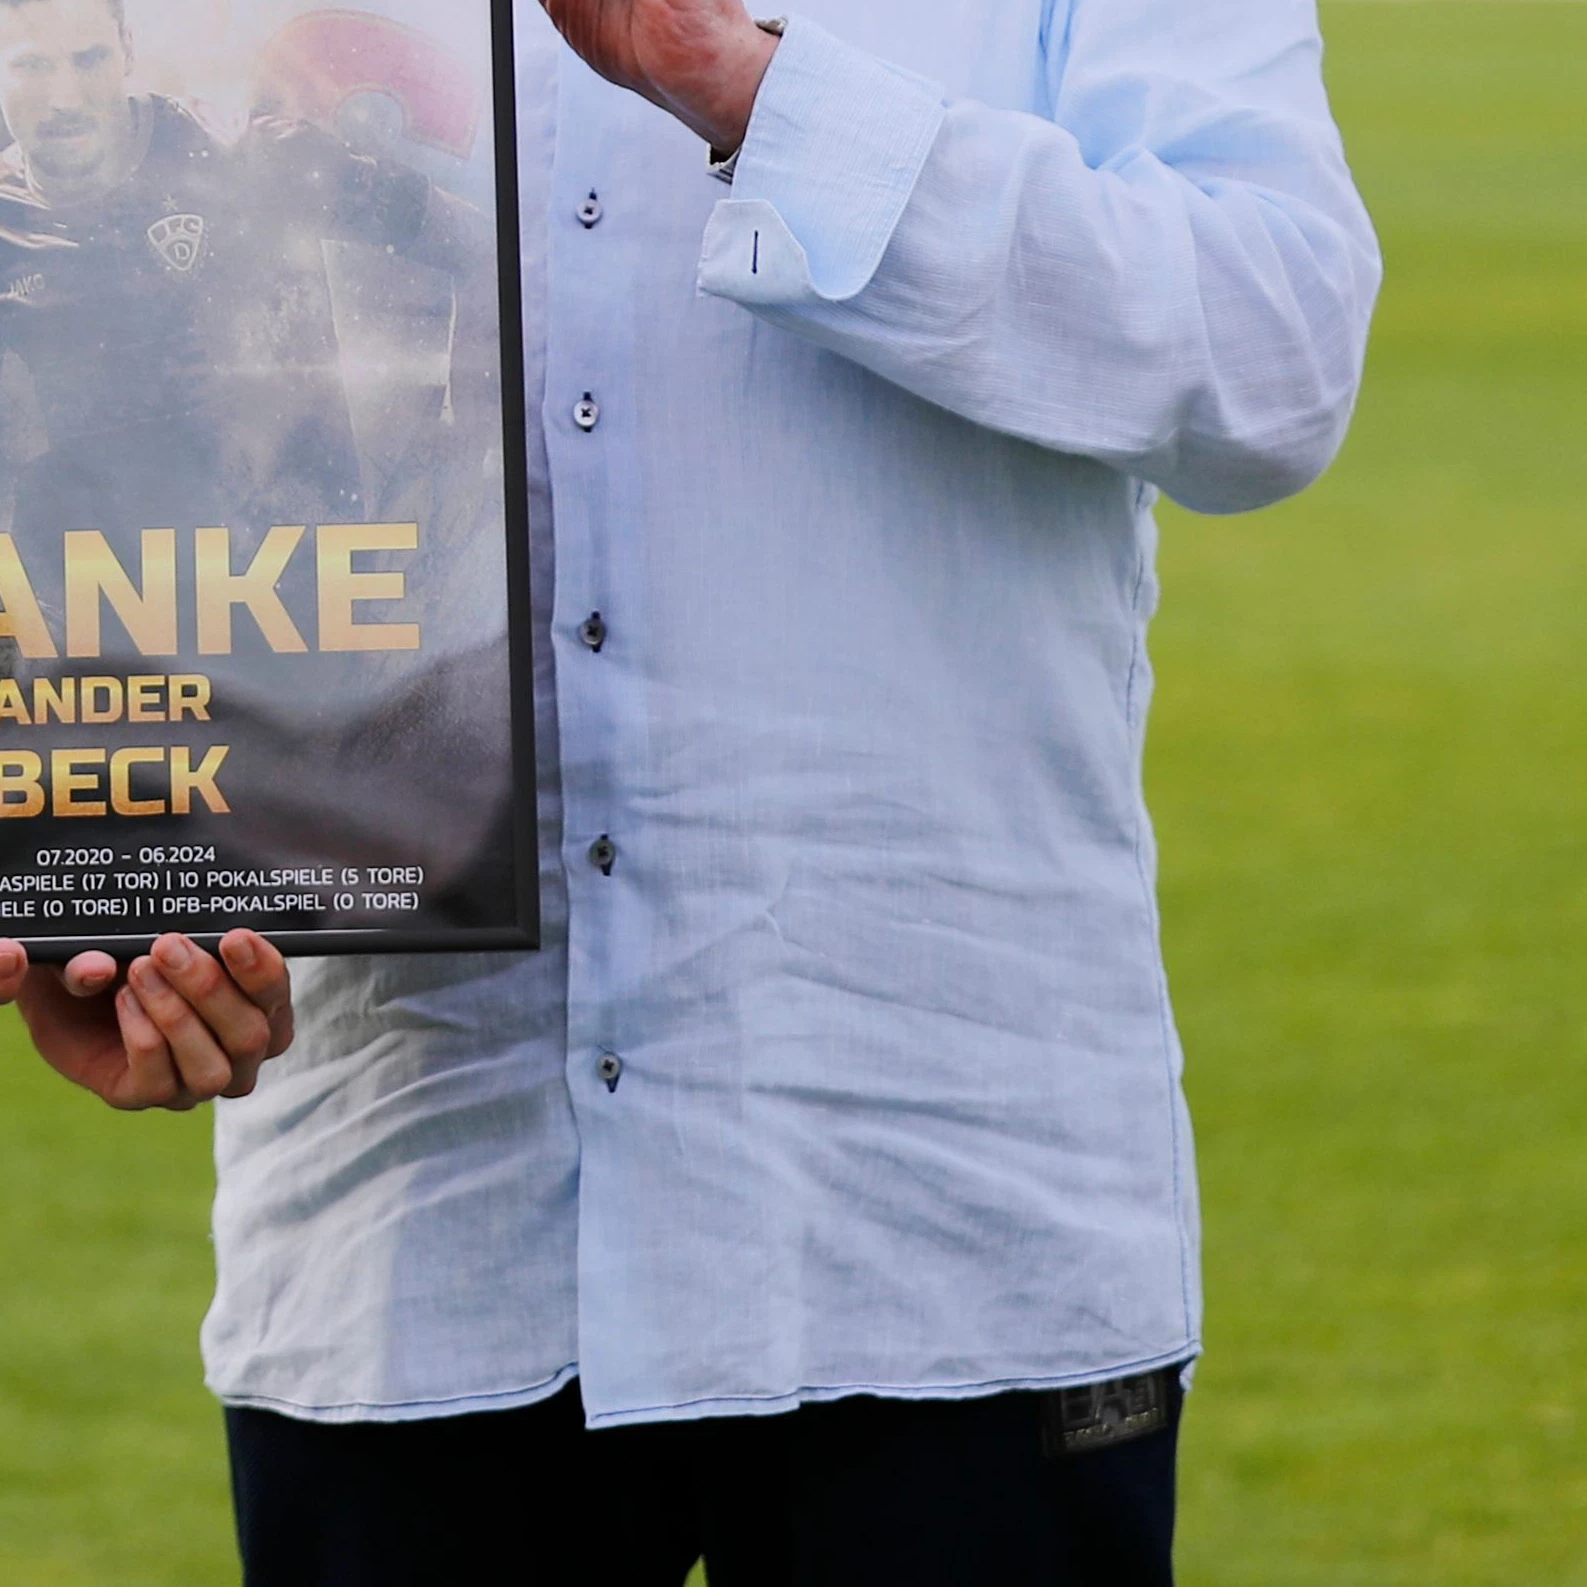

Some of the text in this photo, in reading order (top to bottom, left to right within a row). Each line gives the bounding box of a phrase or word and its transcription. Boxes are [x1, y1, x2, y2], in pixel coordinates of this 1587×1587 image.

[36, 848, 113, 866] 07.2020
[139, 845, 216, 864] 06.2024
[82, 873, 106, 892] (17
[114, 872, 159, 891] TOR)
[179, 871, 199, 889] 10
[207, 868, 334, 888] POKALSPIELE
[341, 868, 359, 886] (5
[367, 866, 424, 886] TORE)
[72, 898, 128, 918] TORE)
[148, 897, 155, 914] 1
[162, 893, 325, 914] DFB-POKALSPIEL
[363, 892, 420, 911] TORE)
